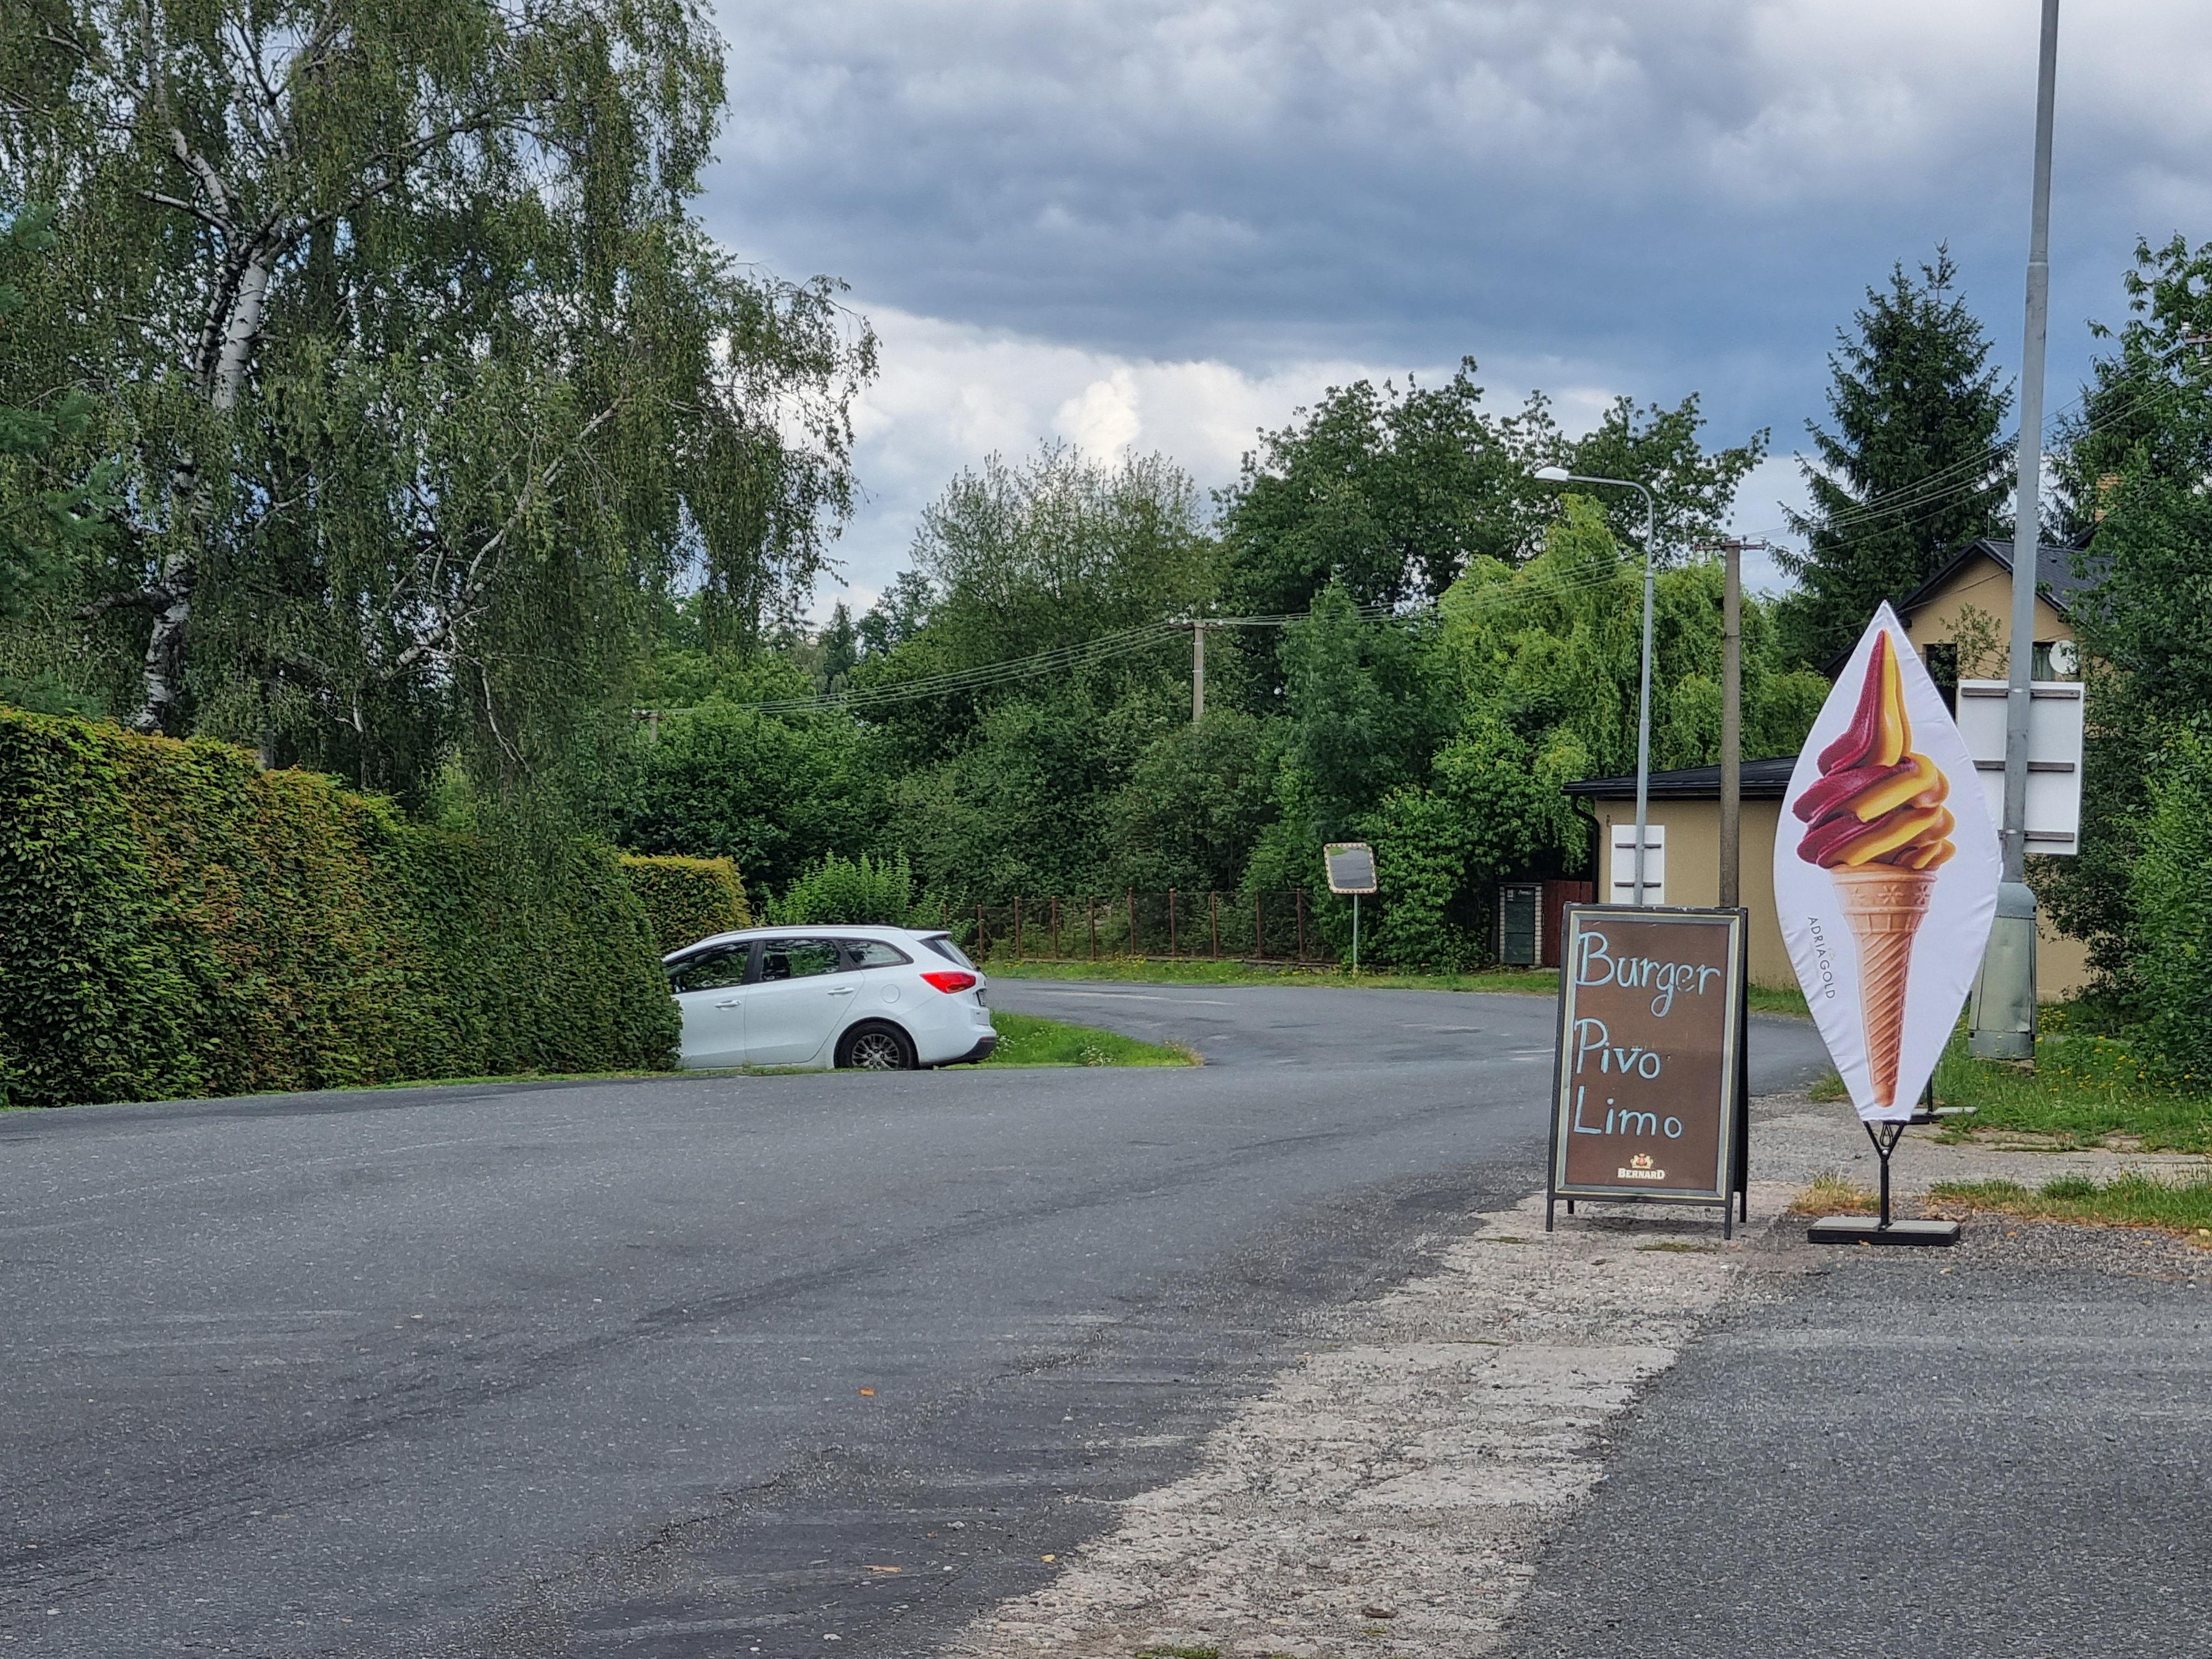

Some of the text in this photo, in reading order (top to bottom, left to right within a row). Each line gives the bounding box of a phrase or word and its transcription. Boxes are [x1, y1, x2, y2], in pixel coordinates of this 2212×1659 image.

[1575, 932, 1720, 1017] Burger
[1574, 1018, 1661, 1079] Pivo
[1573, 1086, 1682, 1139] Limo
[1617, 1167, 1665, 1180] BERNARD
